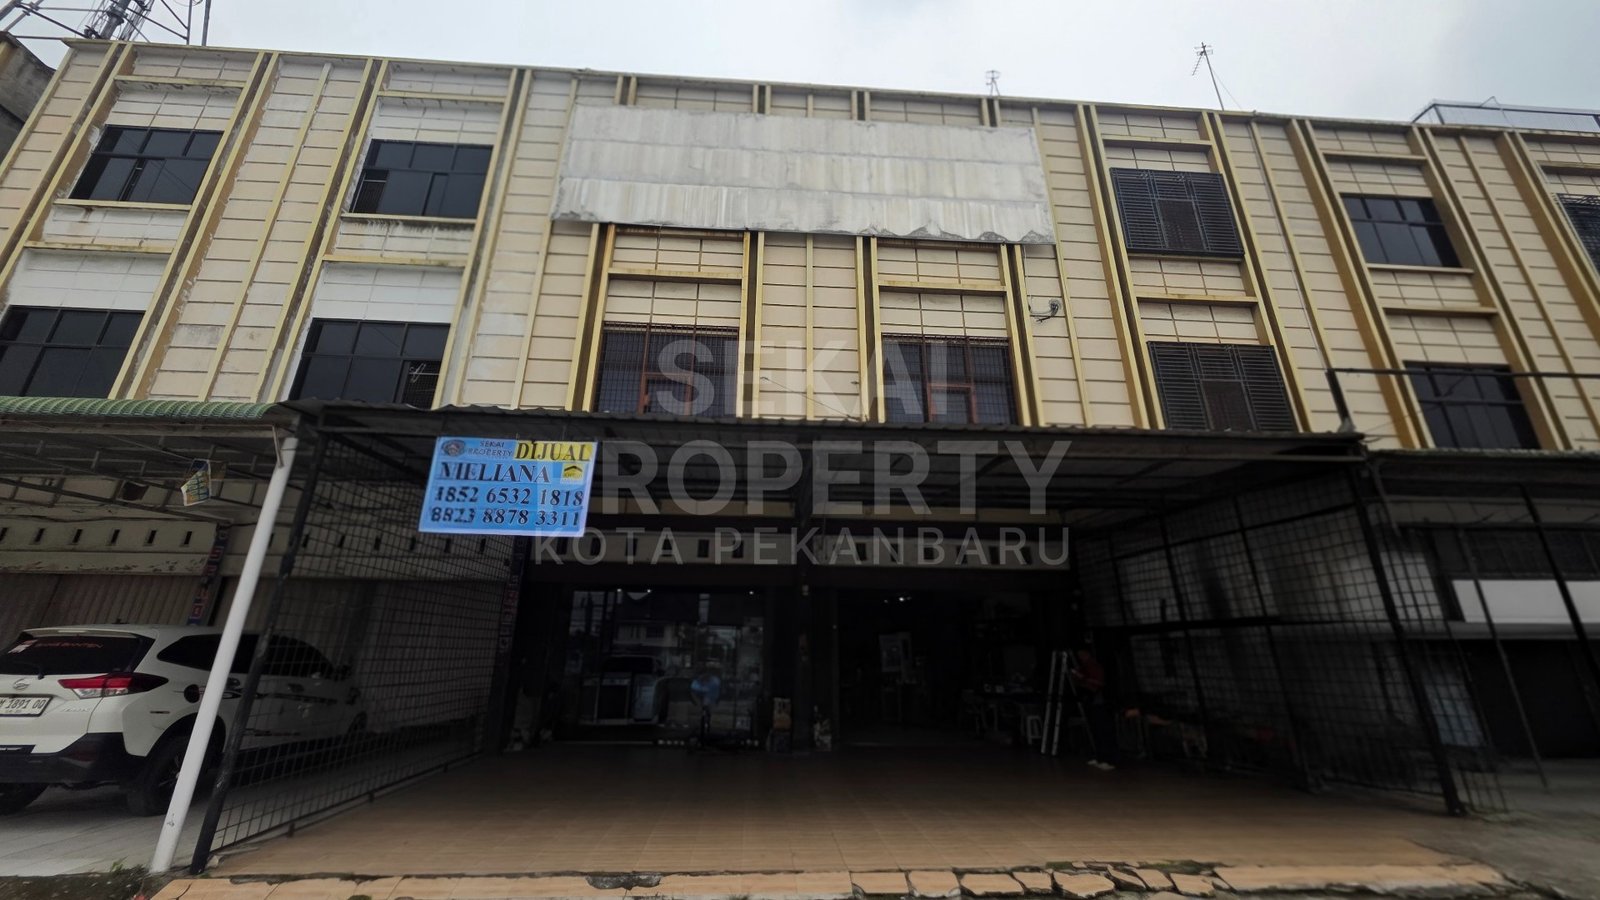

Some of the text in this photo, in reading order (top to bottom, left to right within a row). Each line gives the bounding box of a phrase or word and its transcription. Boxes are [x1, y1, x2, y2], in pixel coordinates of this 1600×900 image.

[479, 440, 505, 448] SEKAI
[515, 442, 591, 462] DIJUAL
[440, 462, 551, 483] MELIANA
[486, 487, 531, 505] 6532
[540, 489, 584, 507] 1818
[482, 508, 529, 525] 8878
[535, 511, 580, 526] 3311
[7, 698, 31, 709] 1891
